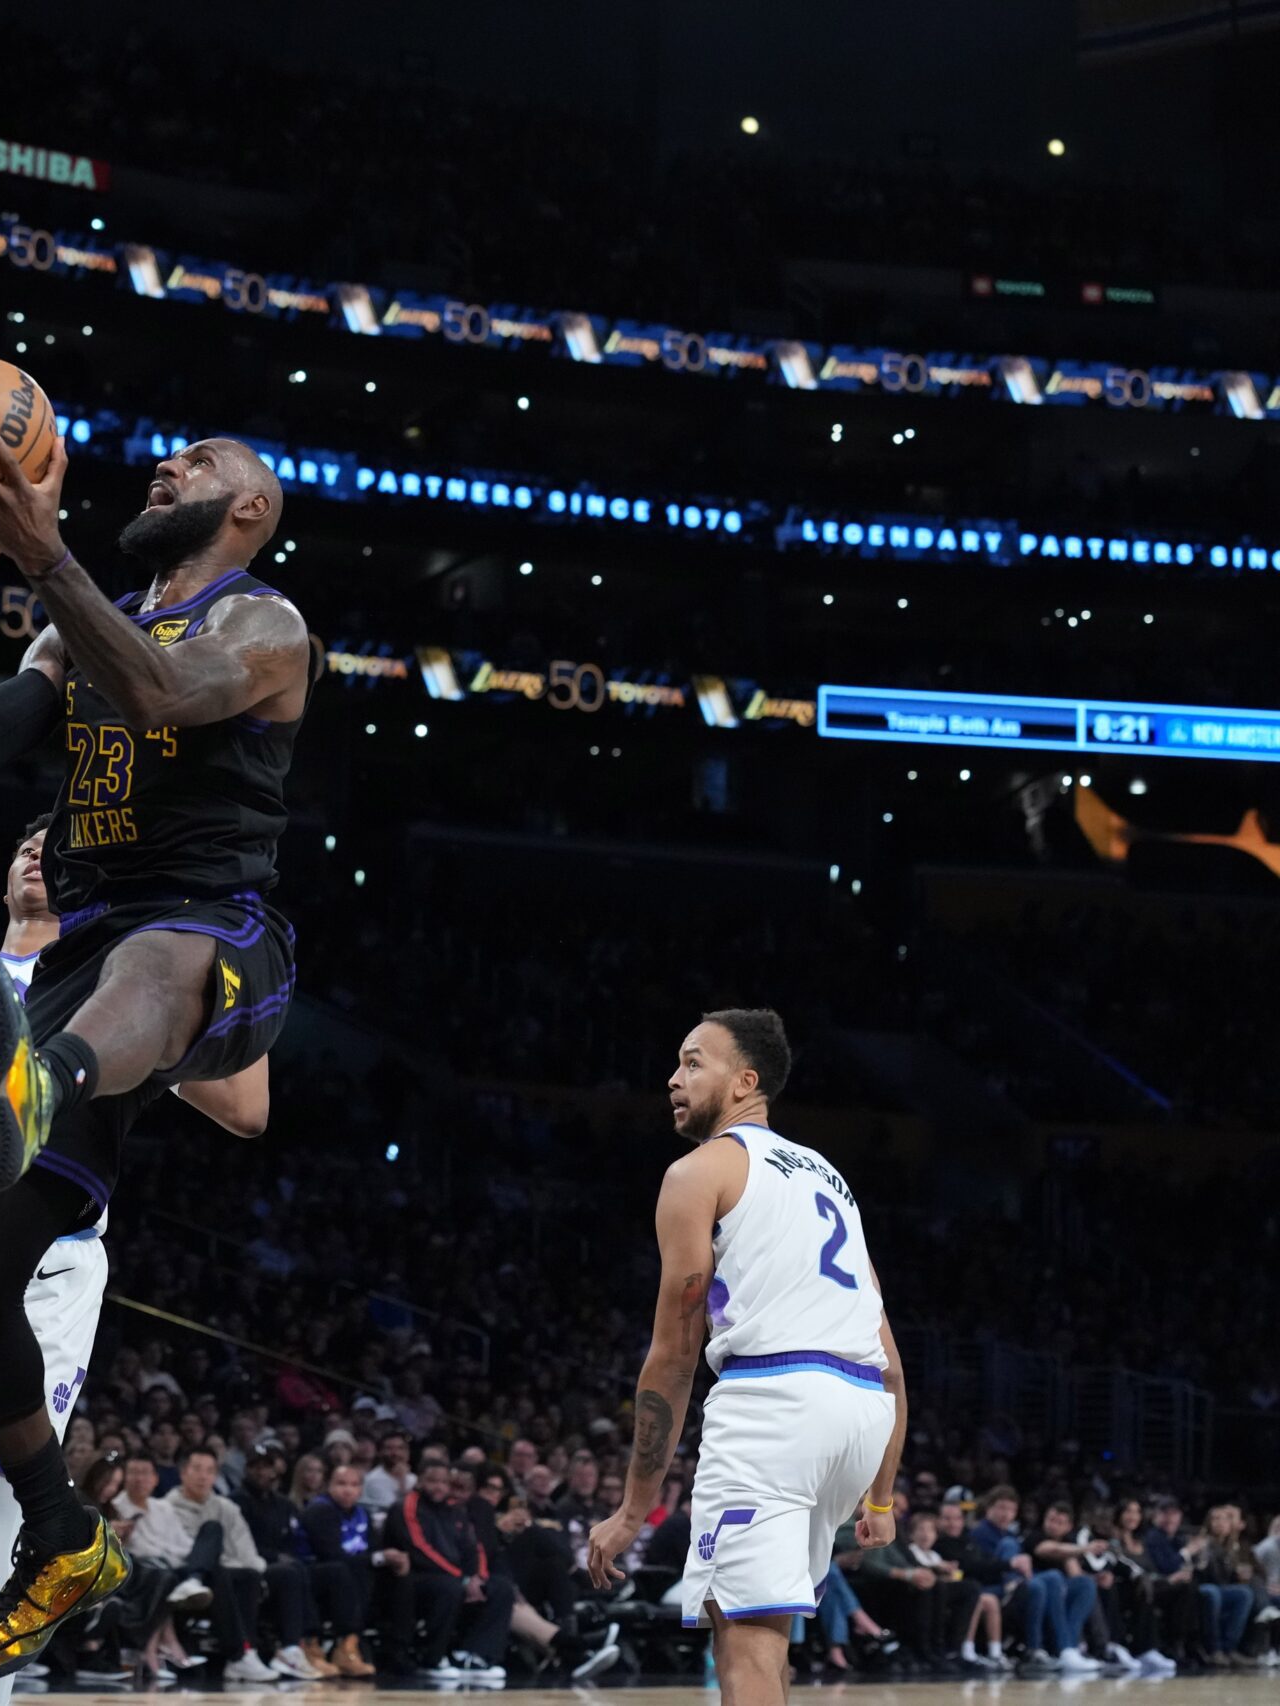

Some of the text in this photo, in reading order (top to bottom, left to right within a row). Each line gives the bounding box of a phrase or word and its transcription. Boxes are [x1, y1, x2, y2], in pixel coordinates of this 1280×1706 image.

[0, 370, 35, 448] Wilso
[356, 467, 532, 509] PARTNERS
[548, 490, 650, 523] SINCE
[1020, 533, 1193, 565] PARTNERS
[548, 660, 605, 712] 50
[67, 722, 135, 807] 23
[71, 807, 140, 848] LAKERS
[815, 1190, 860, 1291] 2
